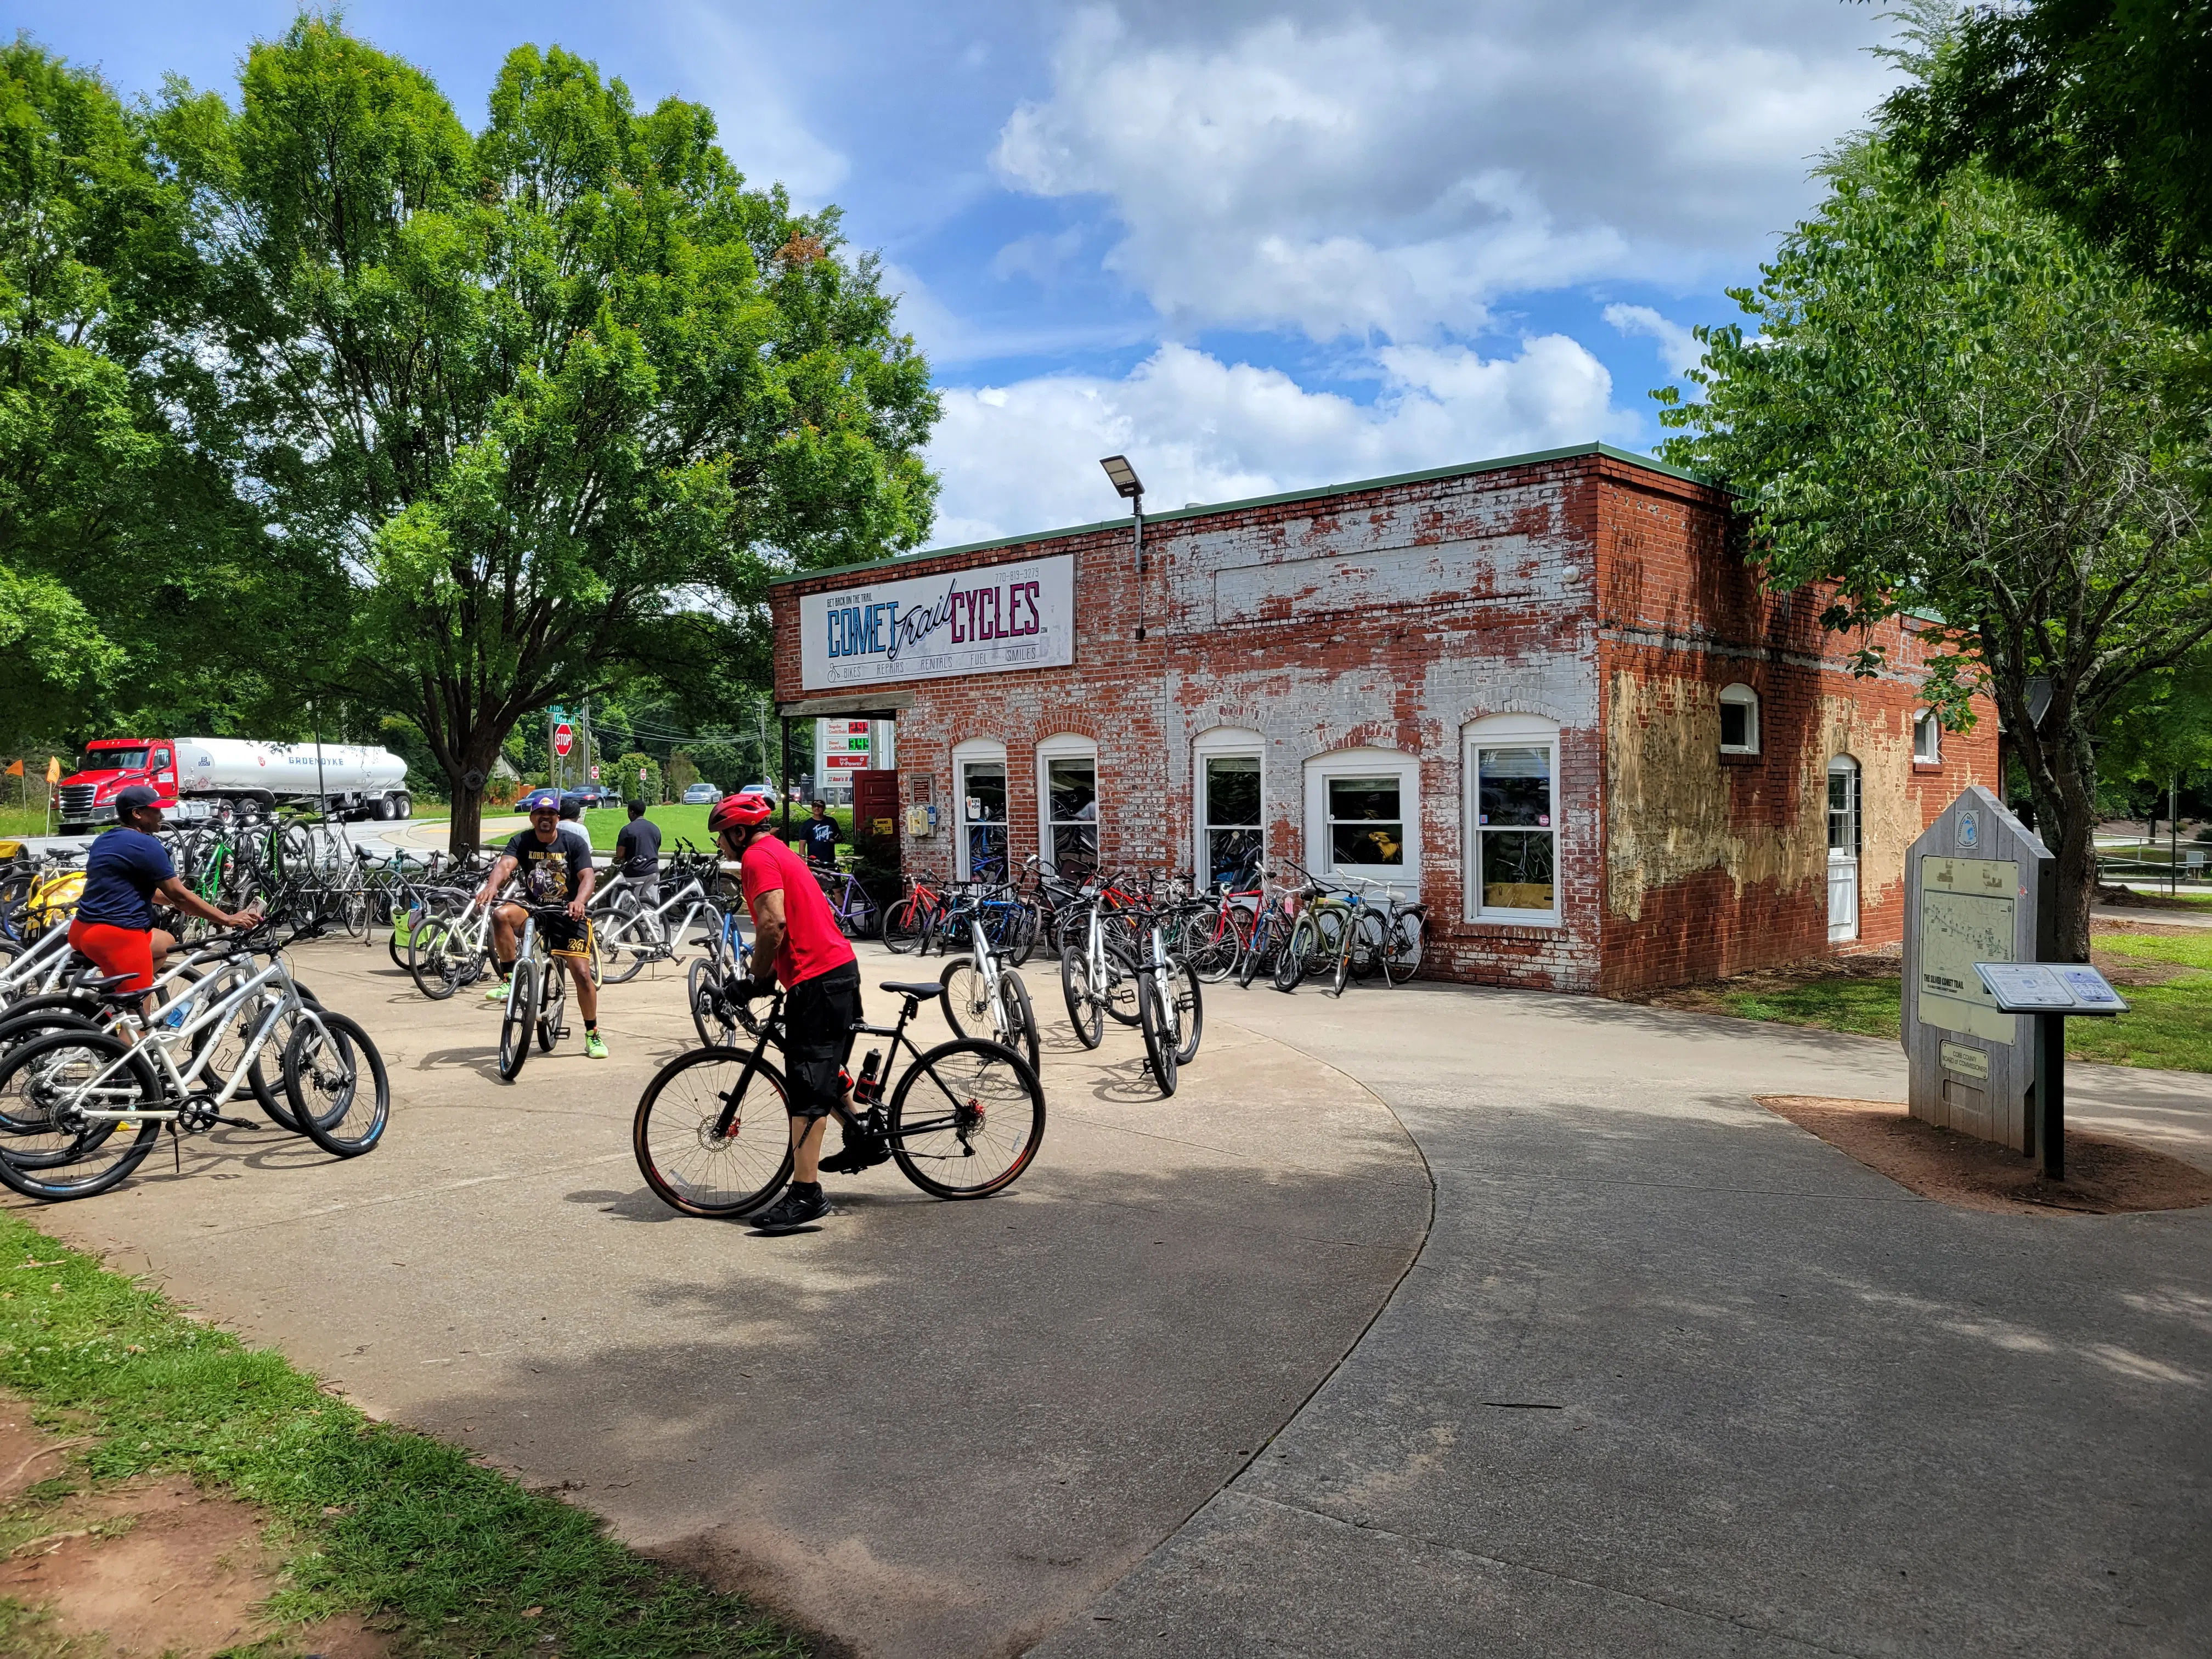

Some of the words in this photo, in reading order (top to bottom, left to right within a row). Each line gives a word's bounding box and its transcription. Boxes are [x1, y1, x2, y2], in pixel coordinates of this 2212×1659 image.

[995, 567, 1039, 583] 770-819-3279
[835, 596, 845, 606] BACK
[846, 595, 852, 605] ON
[861, 592, 873, 602] TRAIL
[827, 601, 899, 658] COMET
[887, 578, 957, 661] Trail
[951, 581, 1040, 644] CYCLES
[844, 667, 861, 678] BIKES
[877, 662, 904, 675] REPAIRS
[921, 657, 952, 671] RENTALS
[970, 653, 988, 665] FUEL
[1007, 647, 1036, 662] SMILES
[556, 733, 571, 746] STOP
[528, 851, 544, 859] KOBE
[546, 851, 567, 860] BRYANT
[567, 938, 585, 952] 24
[46, 959, 68, 991] MARIN
[1930, 974, 1942, 984] SILVER
[1942, 977, 1954, 988] COMET
[1954, 980, 1964, 989] TRAIL
[212, 1007, 239, 1047] MARIN
[245, 1023, 274, 1066] MARIN
